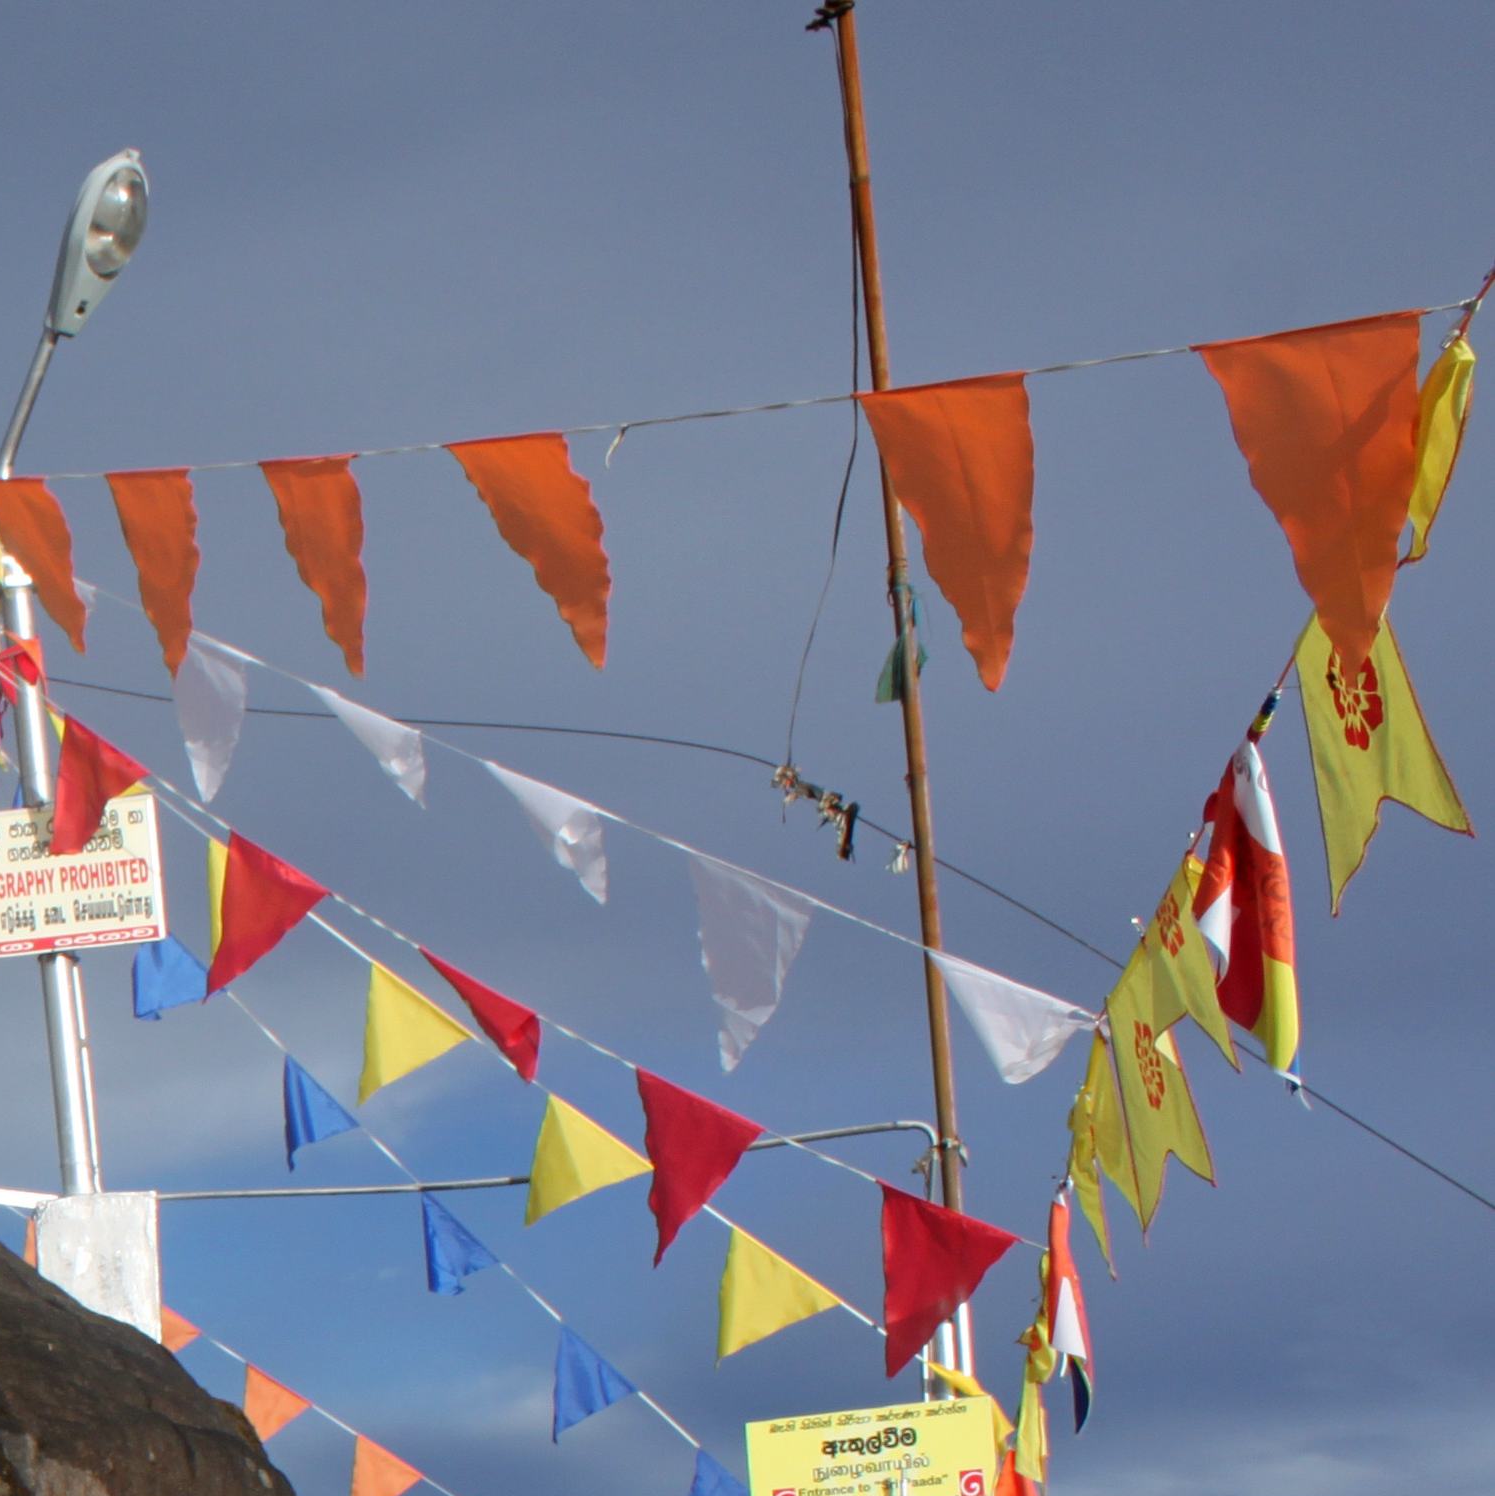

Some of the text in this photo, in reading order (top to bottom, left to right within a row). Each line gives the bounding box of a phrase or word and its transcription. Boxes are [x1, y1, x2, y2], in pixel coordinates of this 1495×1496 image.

[59, 857, 148, 891] PROHIBITED
[821, 1426, 916, 1458] ඇතුල්වීම
[858, 1483, 871, 1493] to
